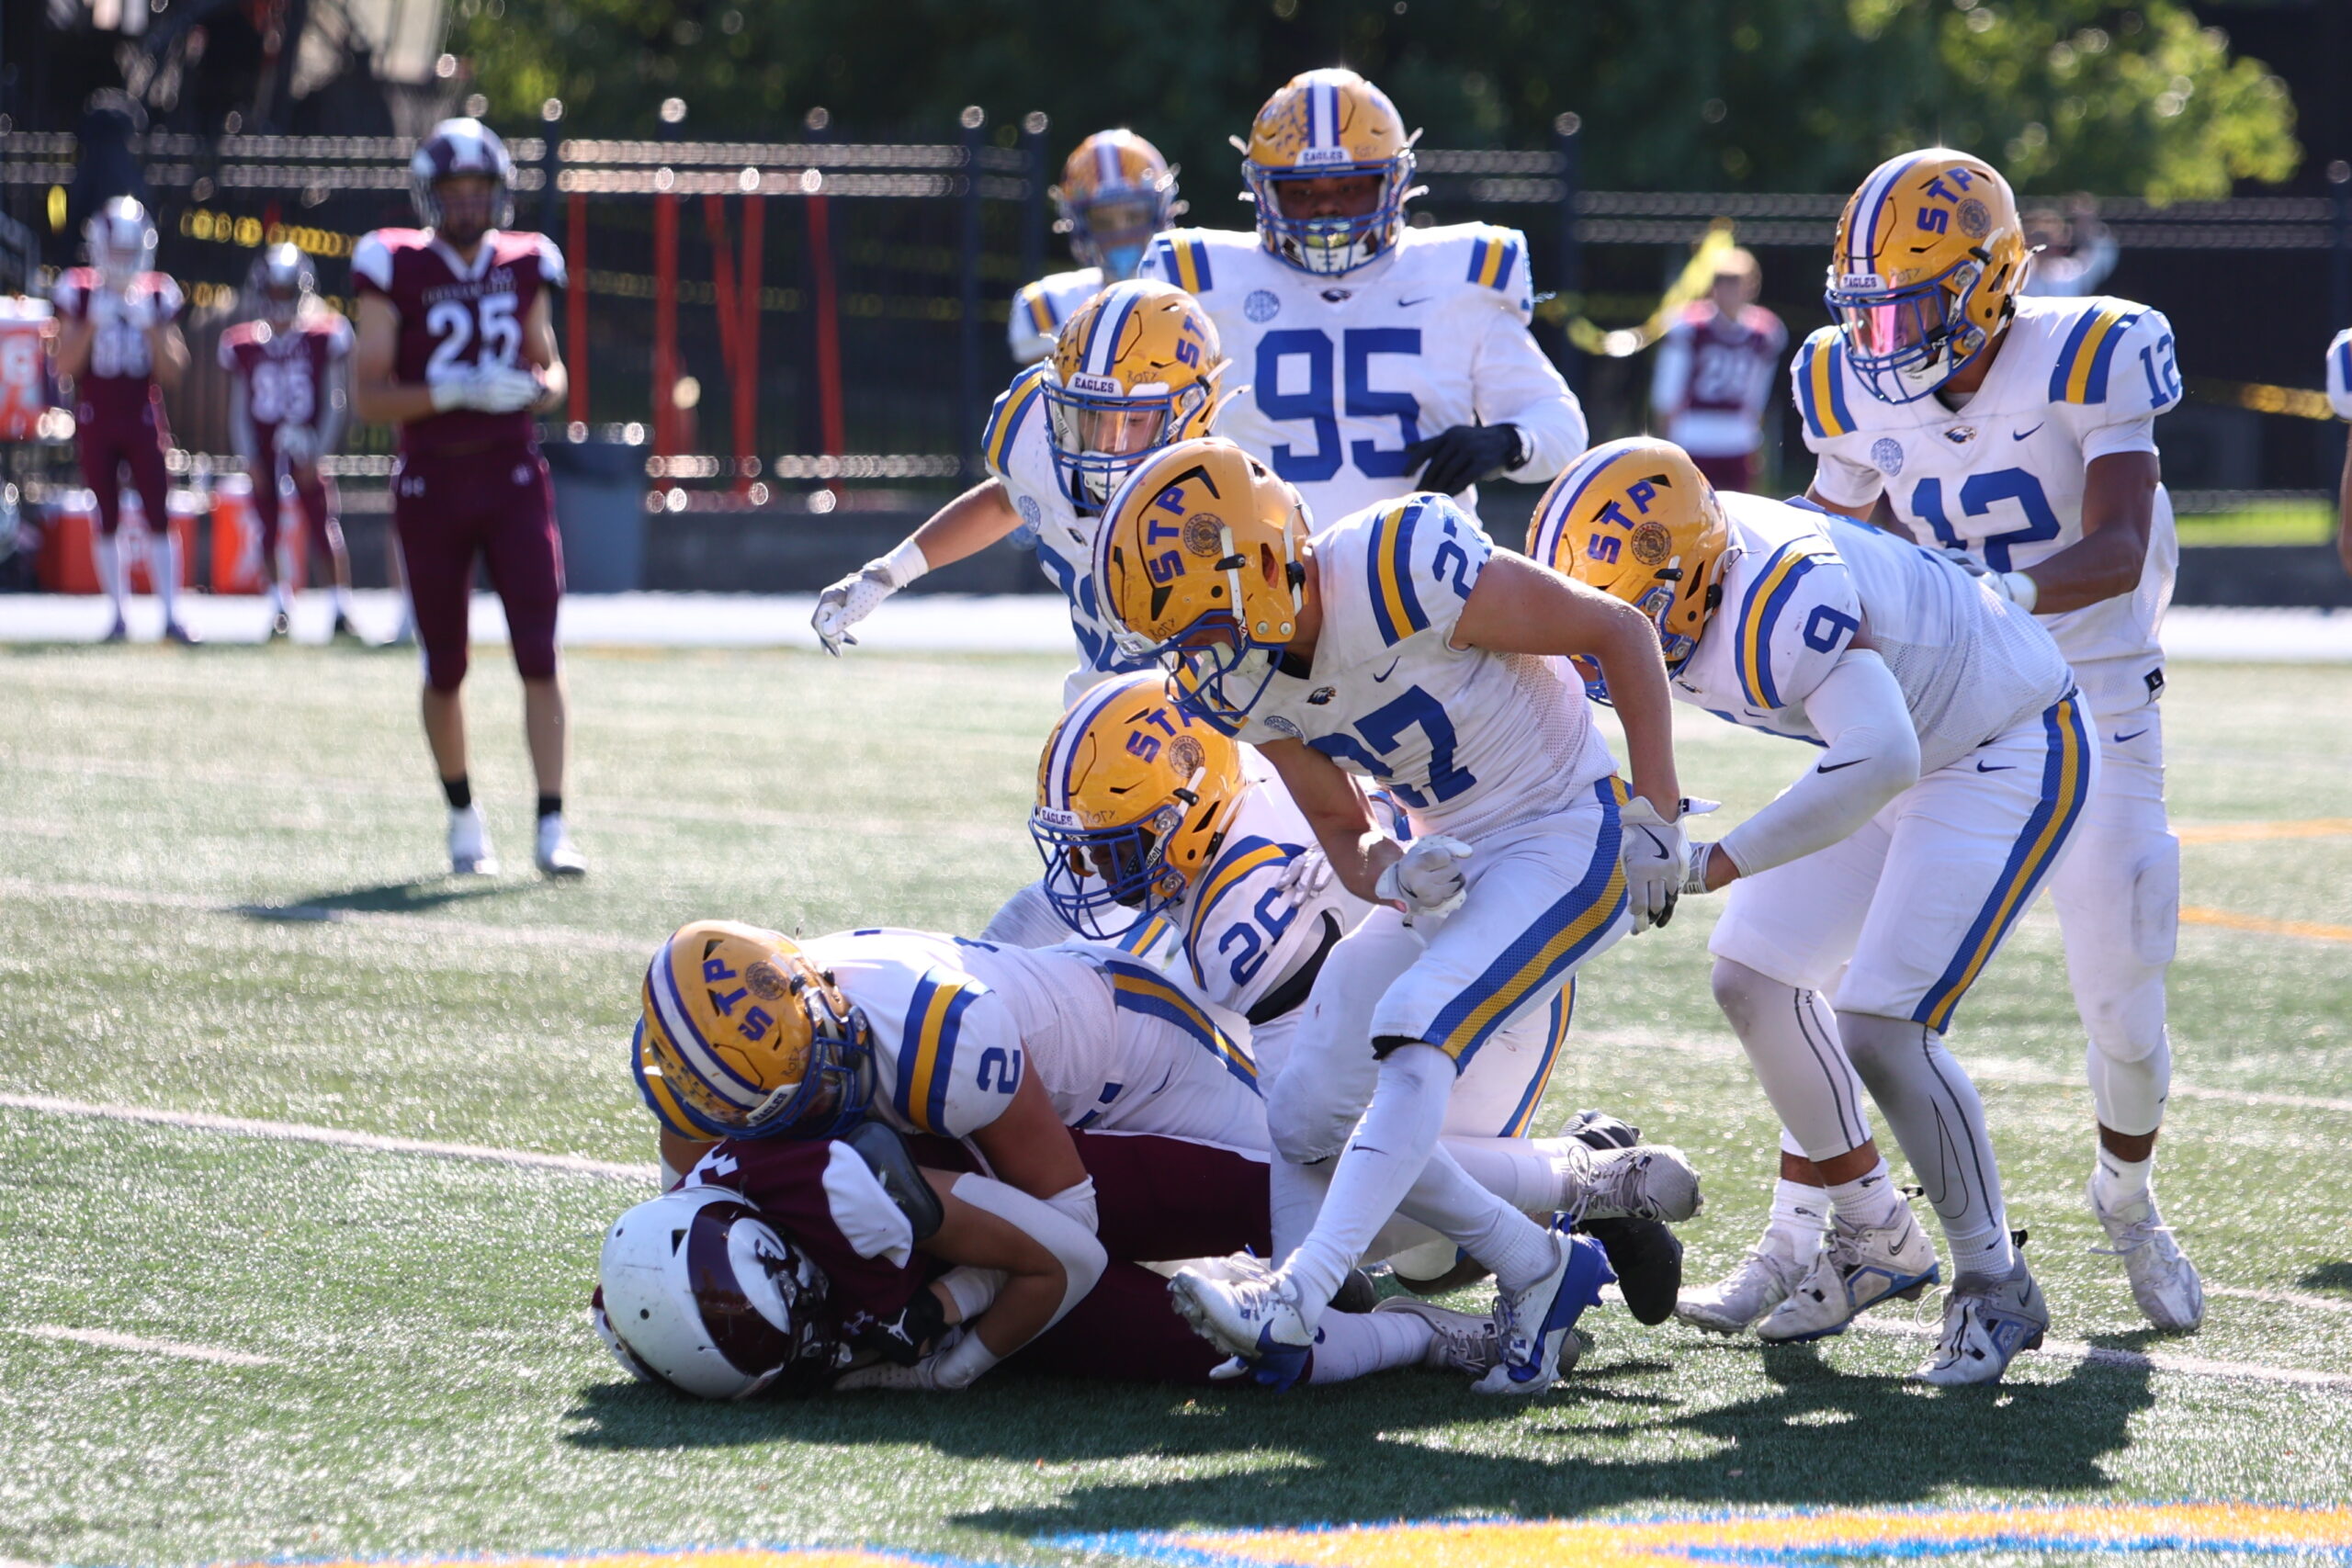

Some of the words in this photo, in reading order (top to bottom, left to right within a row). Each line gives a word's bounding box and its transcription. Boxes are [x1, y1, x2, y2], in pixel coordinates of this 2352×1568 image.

[1917, 166, 1973, 235] STP
[424, 291, 522, 383] 25
[1175, 309, 1206, 370] ST
[2139, 333, 2179, 410] 12
[1074, 377, 1114, 394] EAGLES
[1255, 328, 1421, 482] 95
[1148, 486, 1186, 584] STP
[1588, 479, 1657, 565] STP
[1911, 467, 2061, 573] 12
[1803, 604, 1860, 655] 9
[1306, 683, 1477, 809] 27
[1042, 809, 1073, 826] EAGLES
[703, 958, 775, 1042] STP
[752, 1092, 788, 1121] EAGLES
[976, 1047, 1021, 1094] 2
